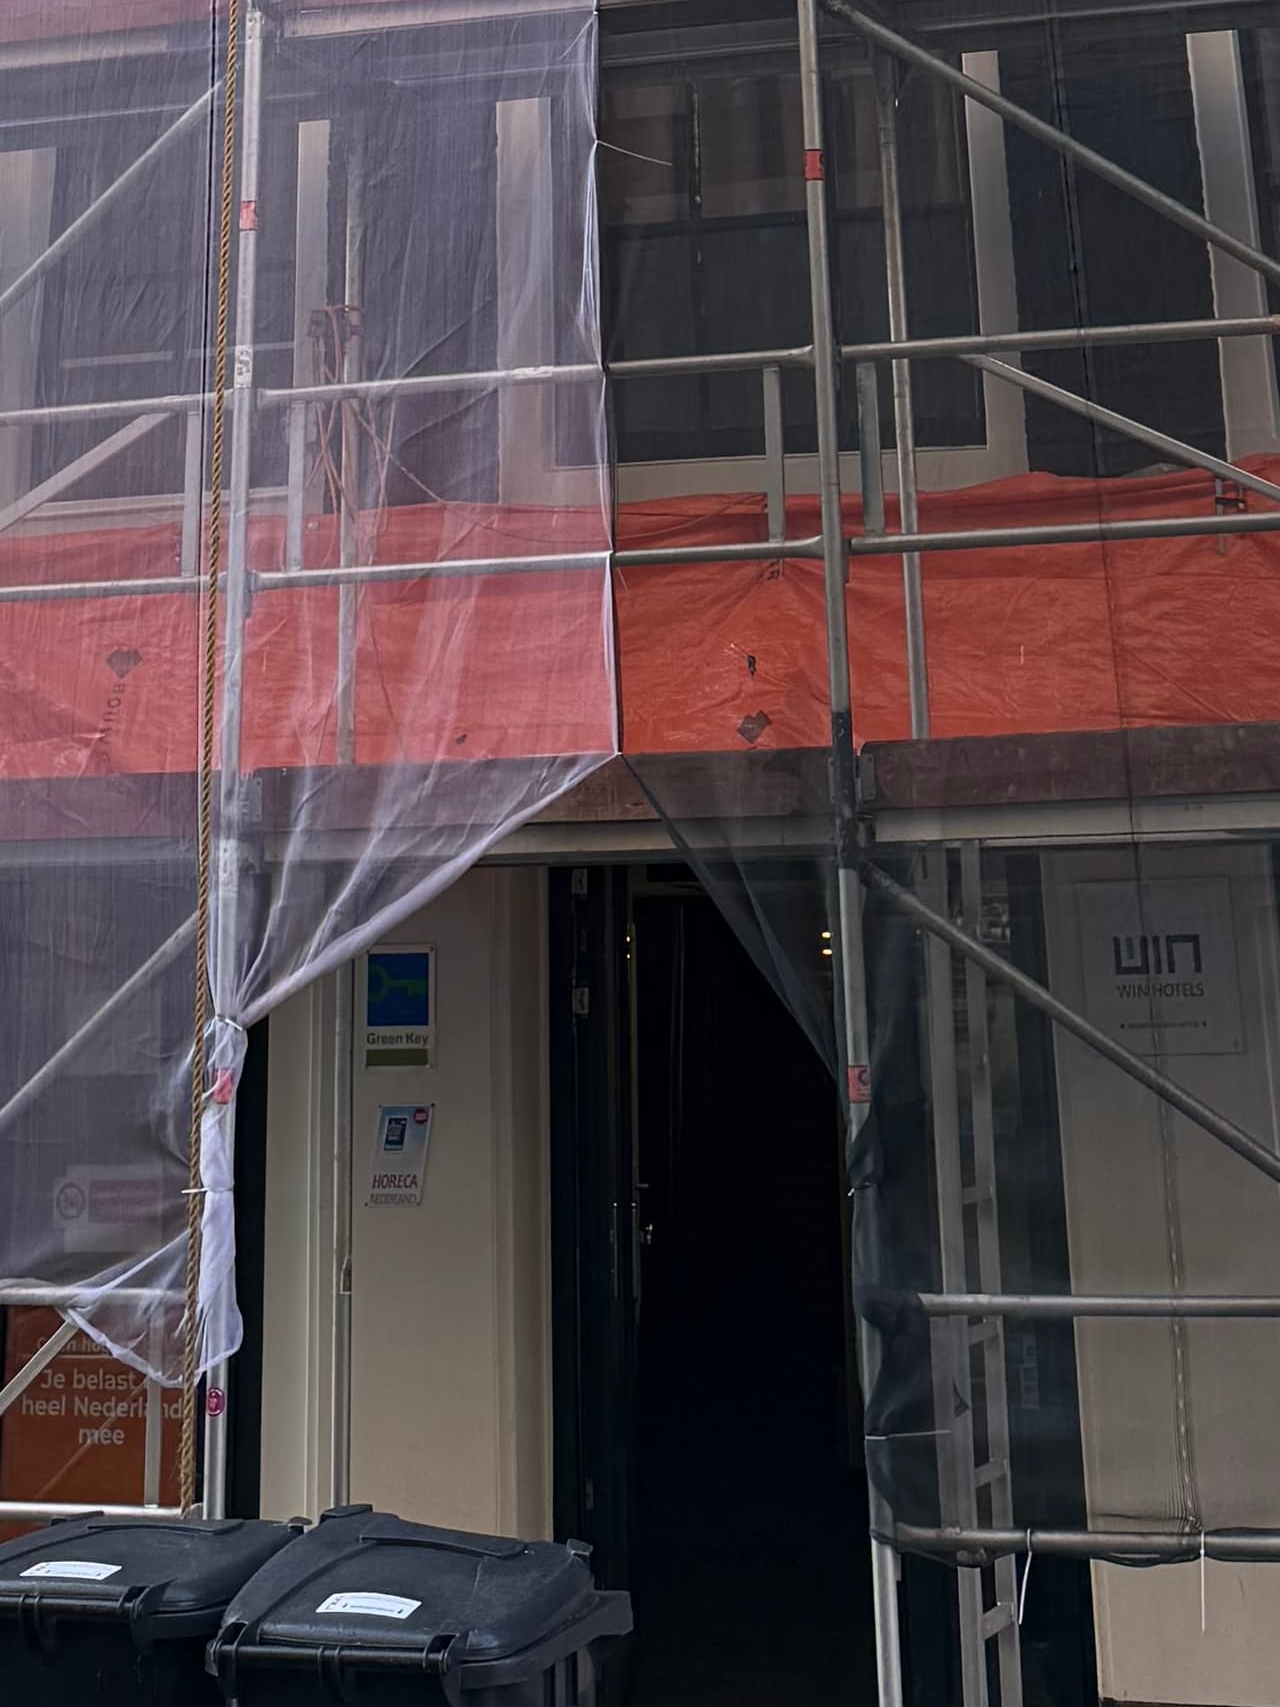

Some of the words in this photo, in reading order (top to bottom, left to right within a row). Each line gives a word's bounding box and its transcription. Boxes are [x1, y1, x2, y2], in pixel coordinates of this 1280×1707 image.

[366, 1032, 405, 1046] Green
[405, 1031, 429, 1048] Key
[372, 1173, 419, 1190] HORECA
[40, 1367, 66, 1390] Je
[73, 1366, 137, 1390] belast
[21, 1394, 67, 1418] heel
[73, 1395, 183, 1420] Nederlnd
[78, 1427, 126, 1445] mee
